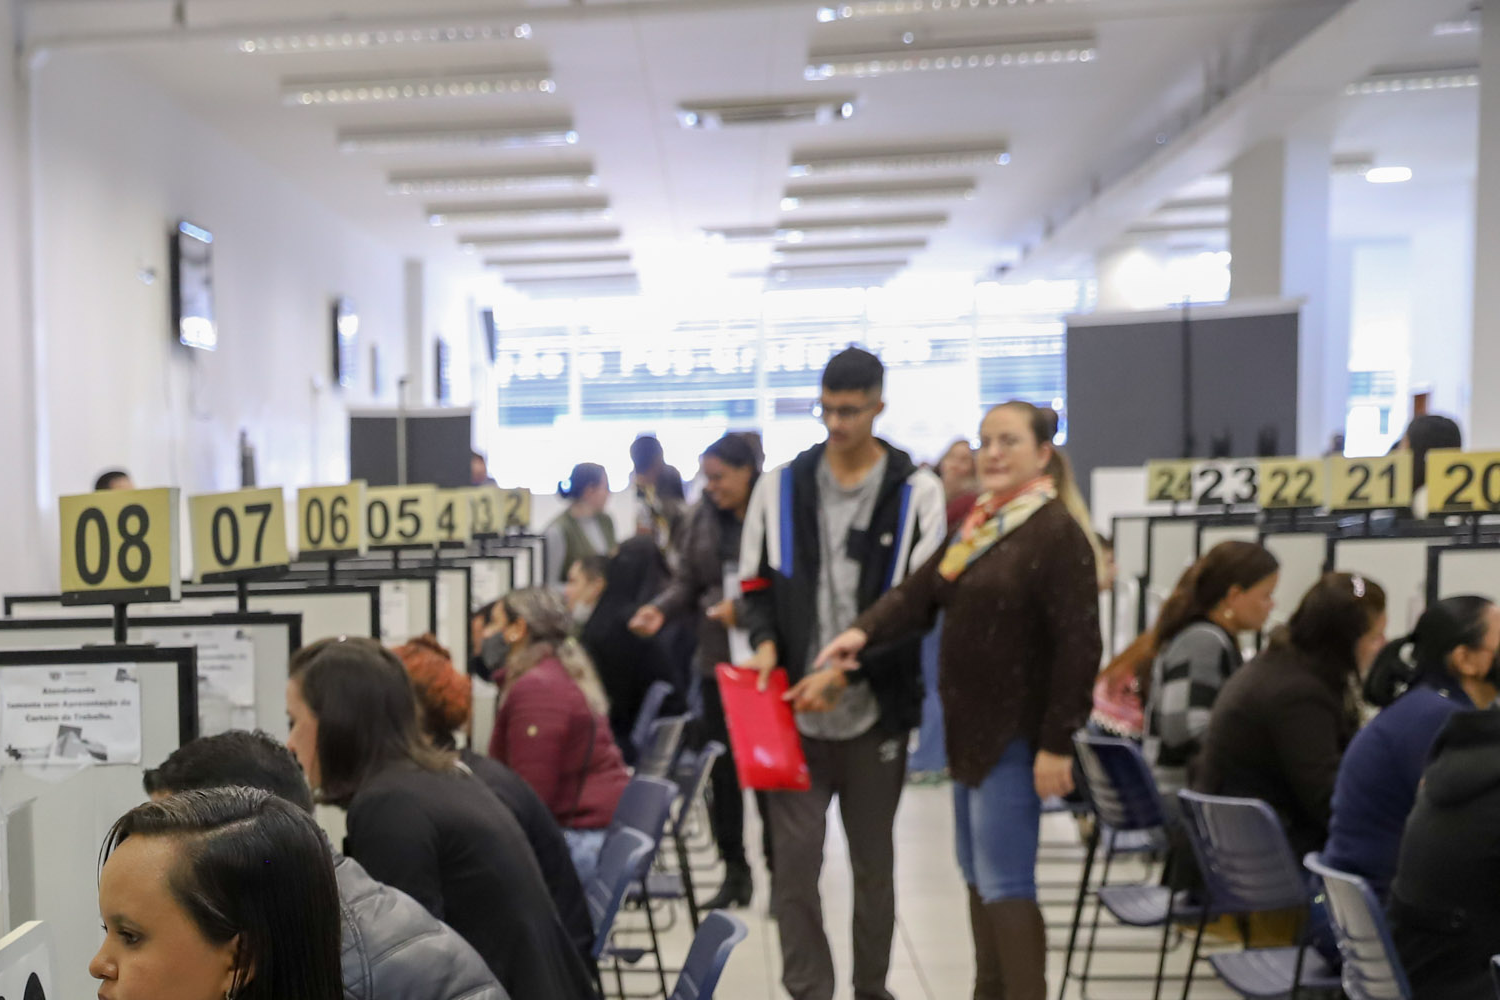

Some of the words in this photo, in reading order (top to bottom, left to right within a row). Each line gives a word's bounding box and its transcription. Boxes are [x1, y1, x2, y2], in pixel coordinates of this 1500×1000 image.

[1199, 466, 1257, 502] 23
[1268, 467, 1315, 504] 22
[1347, 463, 1397, 502] 21
[1444, 463, 1500, 511] 20
[211, 503, 273, 567] 07
[306, 496, 349, 546] 06
[367, 498, 421, 539] 05
[437, 502, 456, 540] 4
[75, 503, 151, 585] 08
